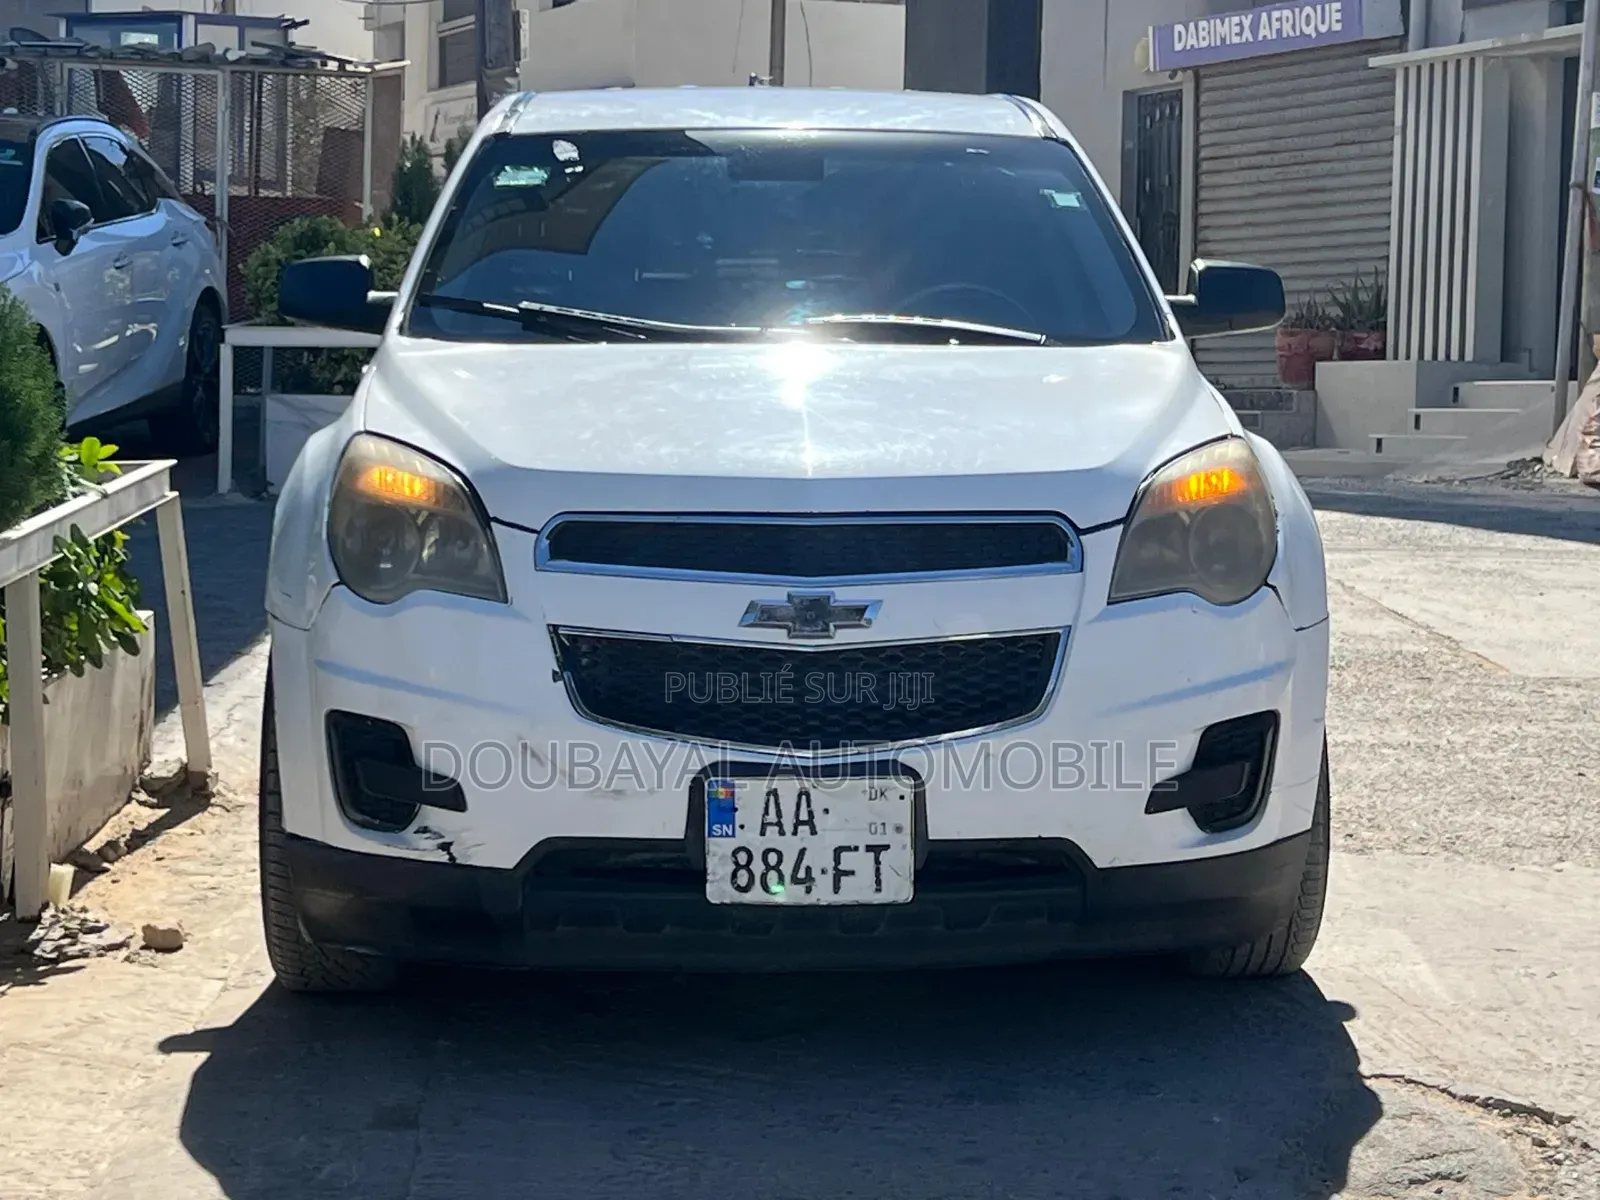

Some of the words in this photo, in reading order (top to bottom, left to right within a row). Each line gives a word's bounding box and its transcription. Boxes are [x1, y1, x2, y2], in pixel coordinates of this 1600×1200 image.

[1173, 14, 1254, 52] DABIMEX
[1258, 2, 1342, 42] AFRIQUE
[868, 788, 889, 802] DK
[759, 787, 818, 836] AA
[711, 823, 734, 836] SN
[868, 822, 888, 836] 01
